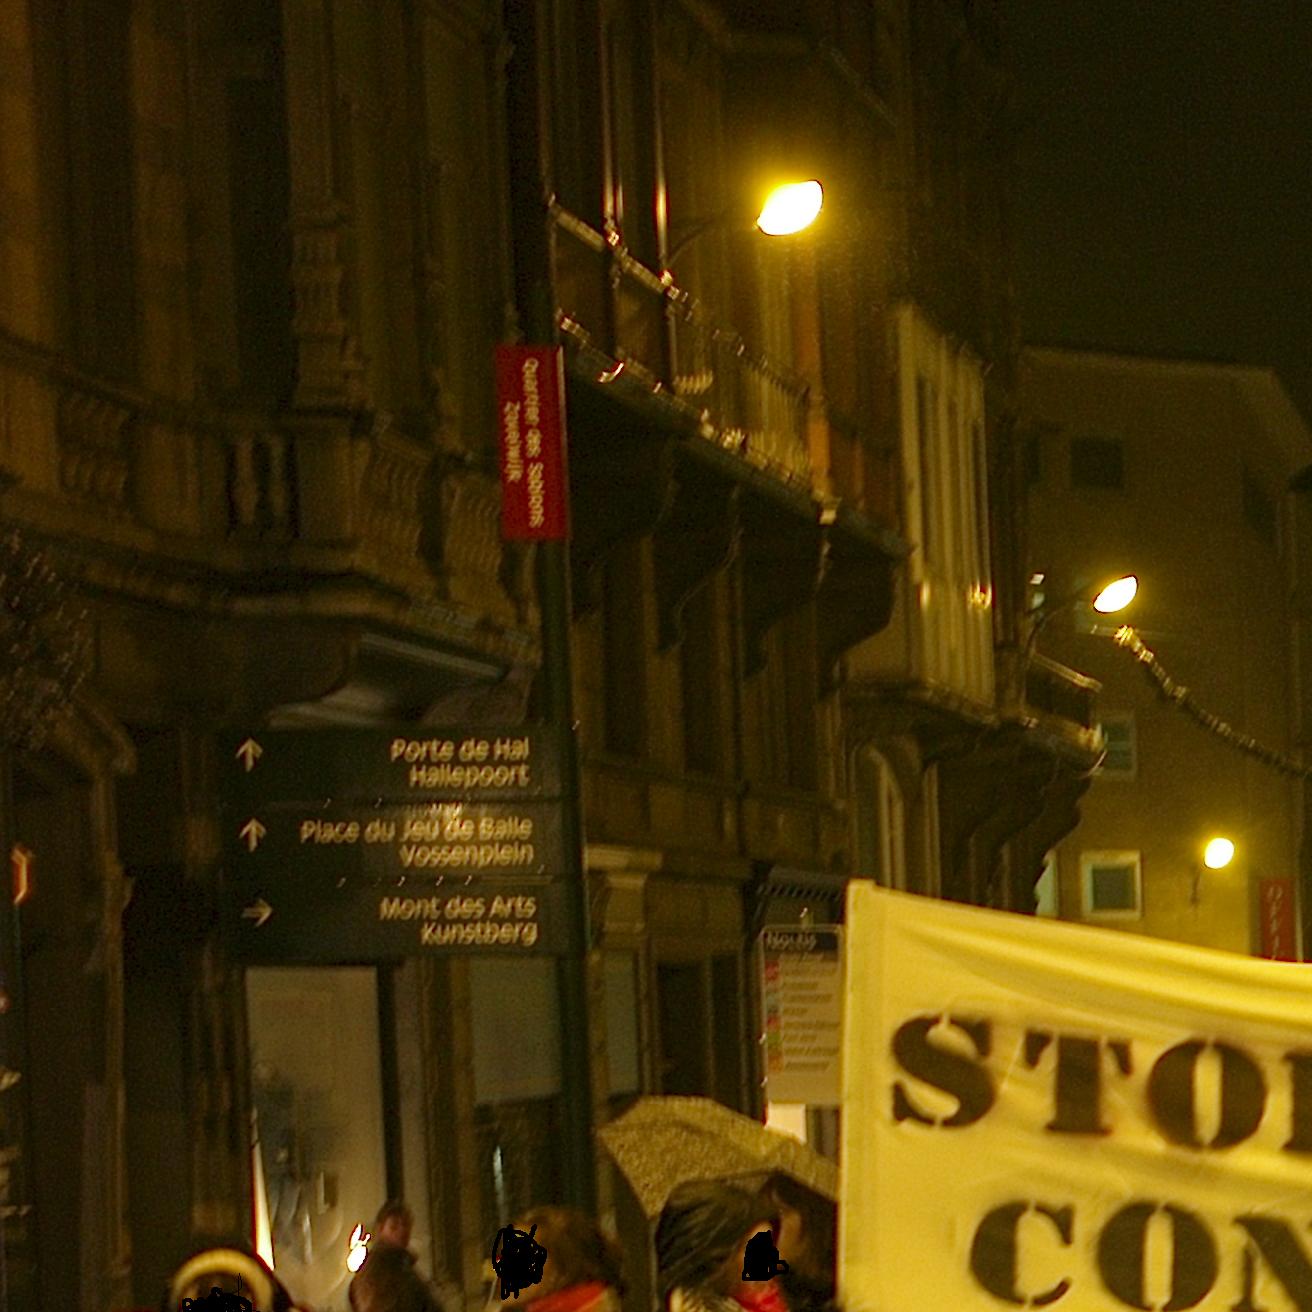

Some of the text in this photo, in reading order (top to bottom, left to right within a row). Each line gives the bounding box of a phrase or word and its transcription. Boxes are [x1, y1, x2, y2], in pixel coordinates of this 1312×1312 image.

[526, 427, 542, 458] des
[528, 461, 546, 528] Sablons
[391, 738, 530, 763] Porte de Hal
[410, 764, 530, 788] Hallepoort
[300, 816, 533, 844] Place du Jeu de Balle
[401, 842, 533, 867] Vossenplein
[380, 894, 538, 921] Mont des Arts
[420, 920, 540, 947] Kunstberg
